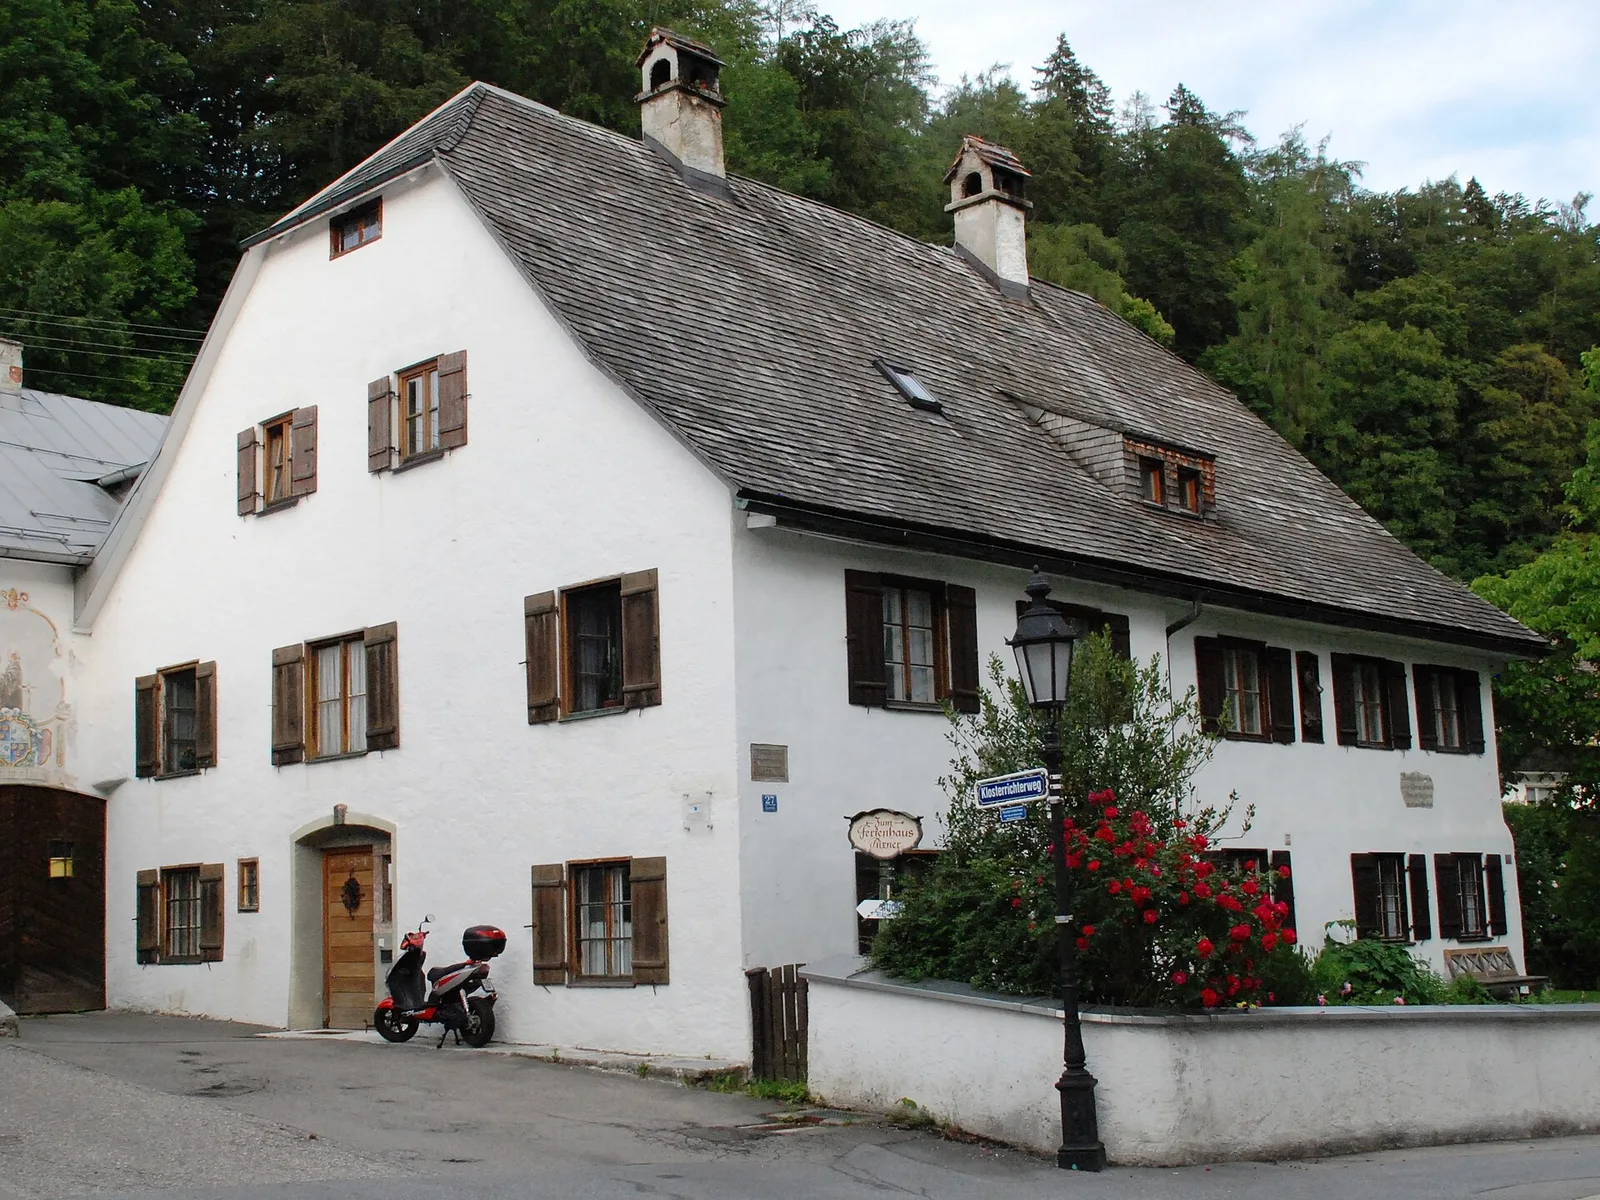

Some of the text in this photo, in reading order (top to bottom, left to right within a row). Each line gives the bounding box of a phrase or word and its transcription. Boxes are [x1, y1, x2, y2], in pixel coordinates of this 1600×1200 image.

[981, 780, 1042, 799] Klosterrichterweg
[764, 795, 775, 804] 27
[874, 816, 893, 827] Zum
[857, 823, 914, 840] Ferienhaus
